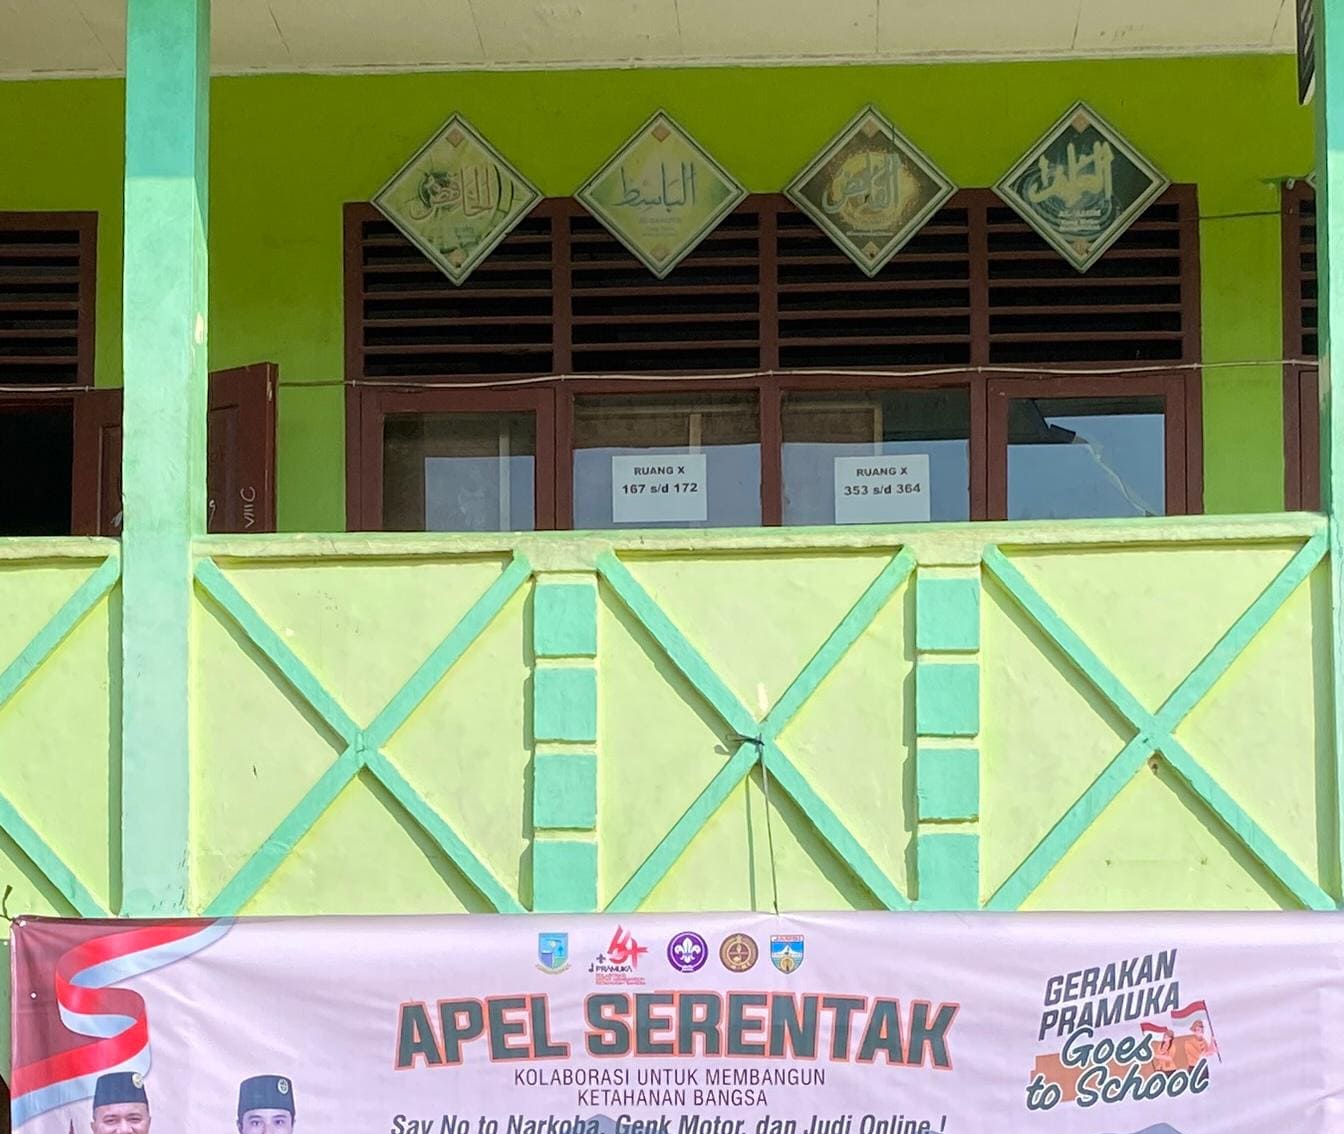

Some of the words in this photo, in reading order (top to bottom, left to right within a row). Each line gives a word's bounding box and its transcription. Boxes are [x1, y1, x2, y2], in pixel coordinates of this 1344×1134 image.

[633, 466, 675, 477] RUANG
[677, 465, 686, 475] X
[856, 467, 897, 478] RUANG
[899, 466, 909, 476] X
[621, 484, 646, 495] 167
[649, 483, 670, 495] s/d
[672, 482, 699, 494] 172
[843, 485, 869, 496] 353
[872, 484, 893, 496] s/d
[896, 483, 922, 495] 364
[1043, 948, 1178, 1007] GERAKAN
[1037, 981, 1181, 1042] PRAMUKA
[394, 994, 572, 1071] APEL
[584, 990, 961, 1071] SERENTAK
[1061, 1027, 1154, 1068] Goes
[514, 1068, 630, 1087] KOLABORASI
[636, 1068, 699, 1086] UNTUK
[704, 1068, 827, 1086] MEMBANGUN
[1025, 1075, 1062, 1111] to
[1076, 1058, 1210, 1108] School
[577, 1088, 686, 1107] KETAHANAN
[693, 1088, 768, 1107] BANGSA
